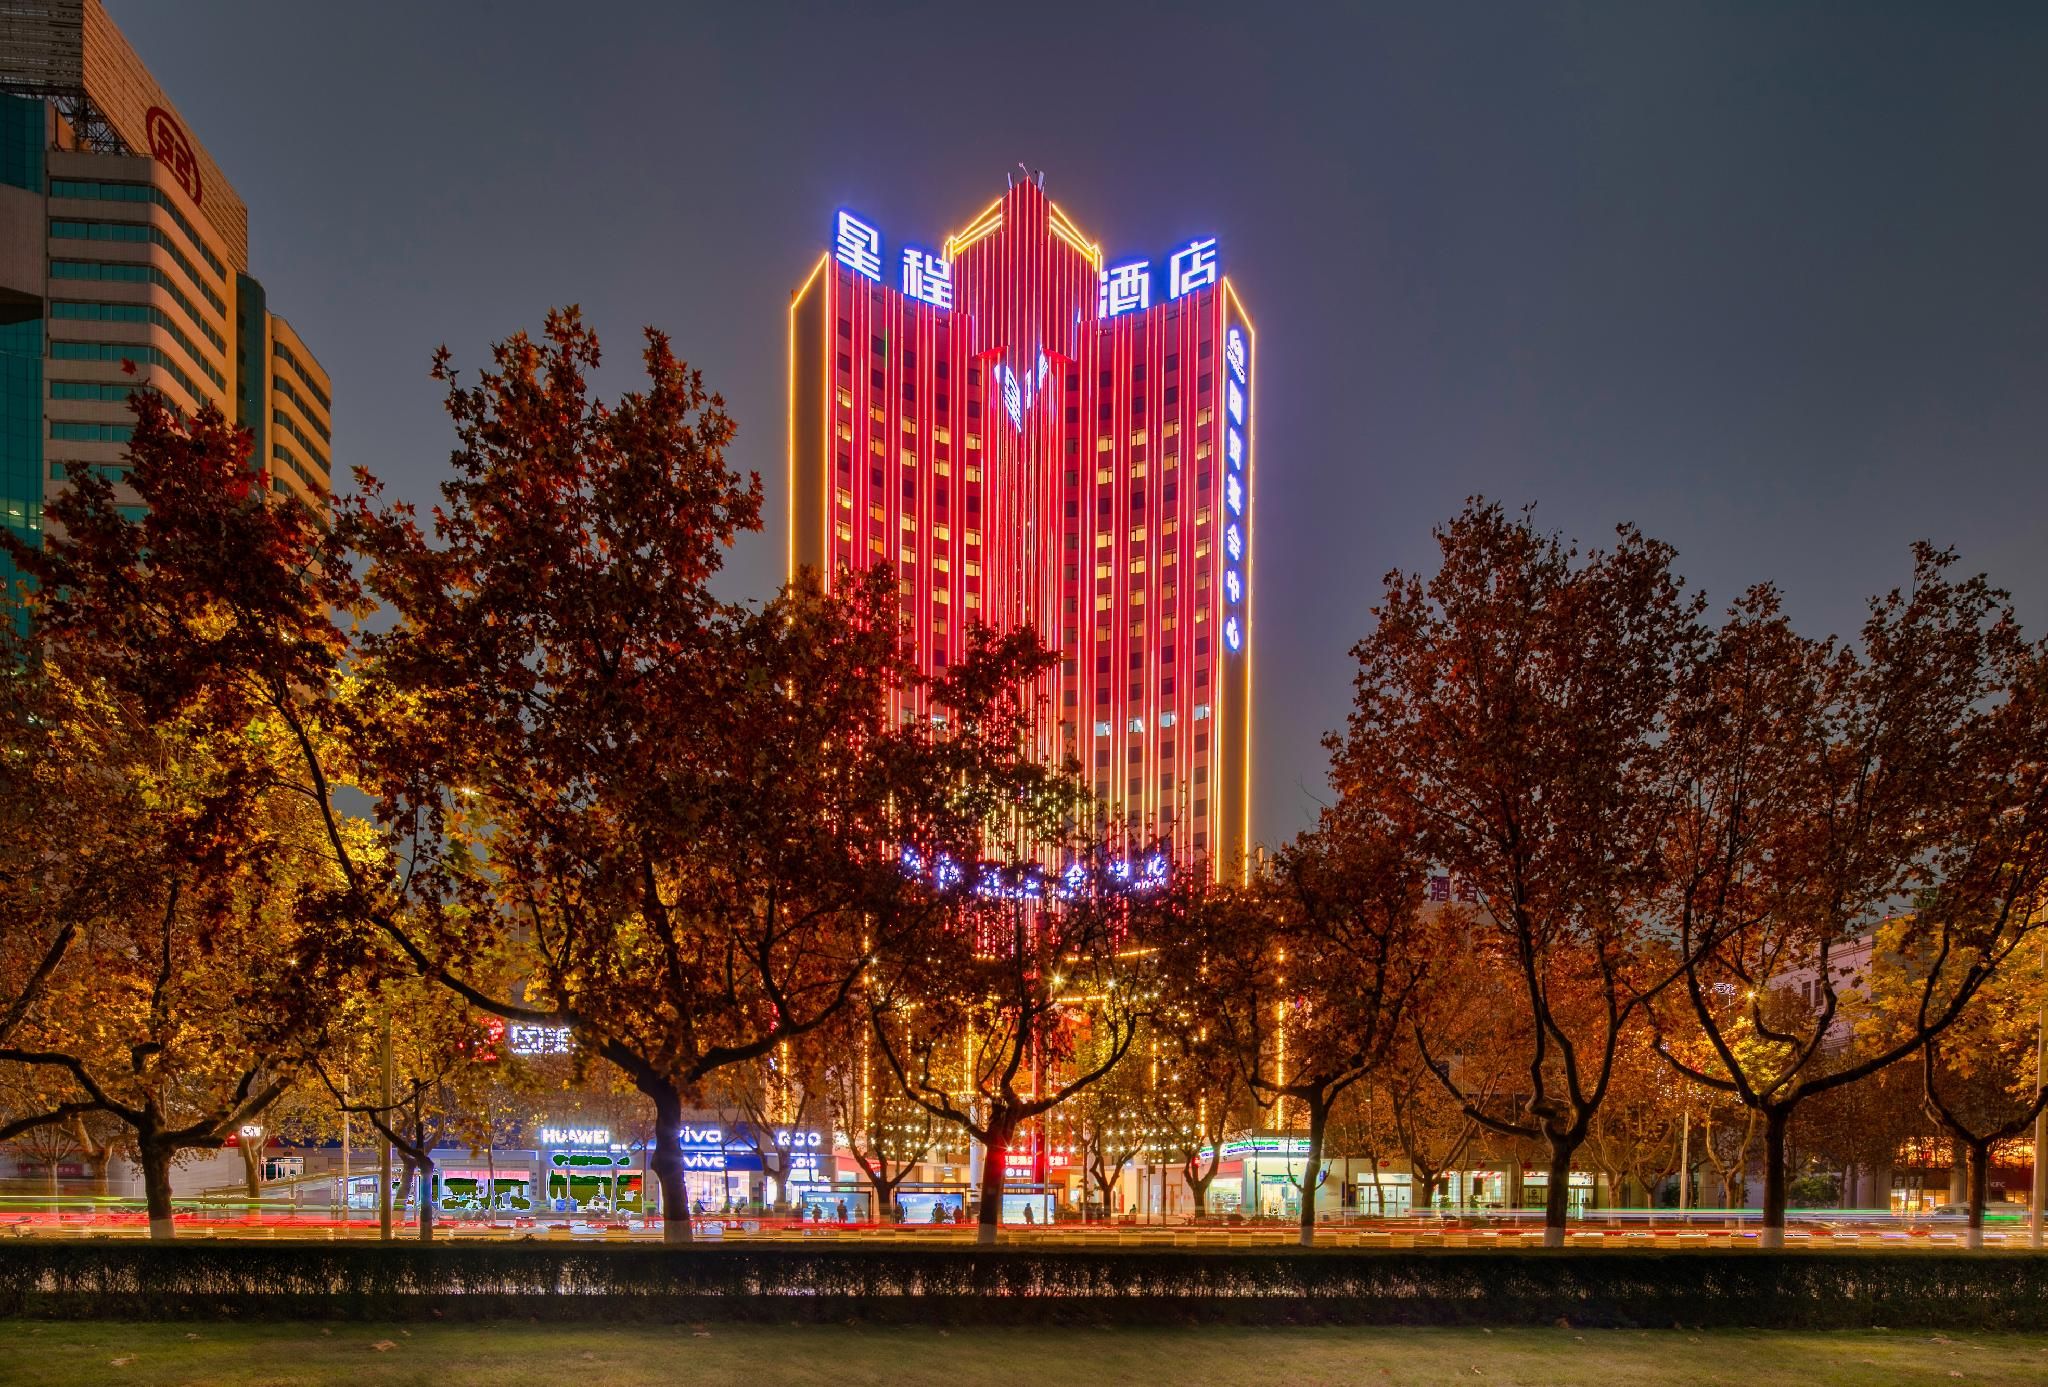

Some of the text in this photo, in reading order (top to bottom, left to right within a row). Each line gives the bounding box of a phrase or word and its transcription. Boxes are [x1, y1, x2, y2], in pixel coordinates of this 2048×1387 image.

[836, 210, 1216, 318] 星程 酒店
[542, 1129, 609, 1143] HUAWEI
